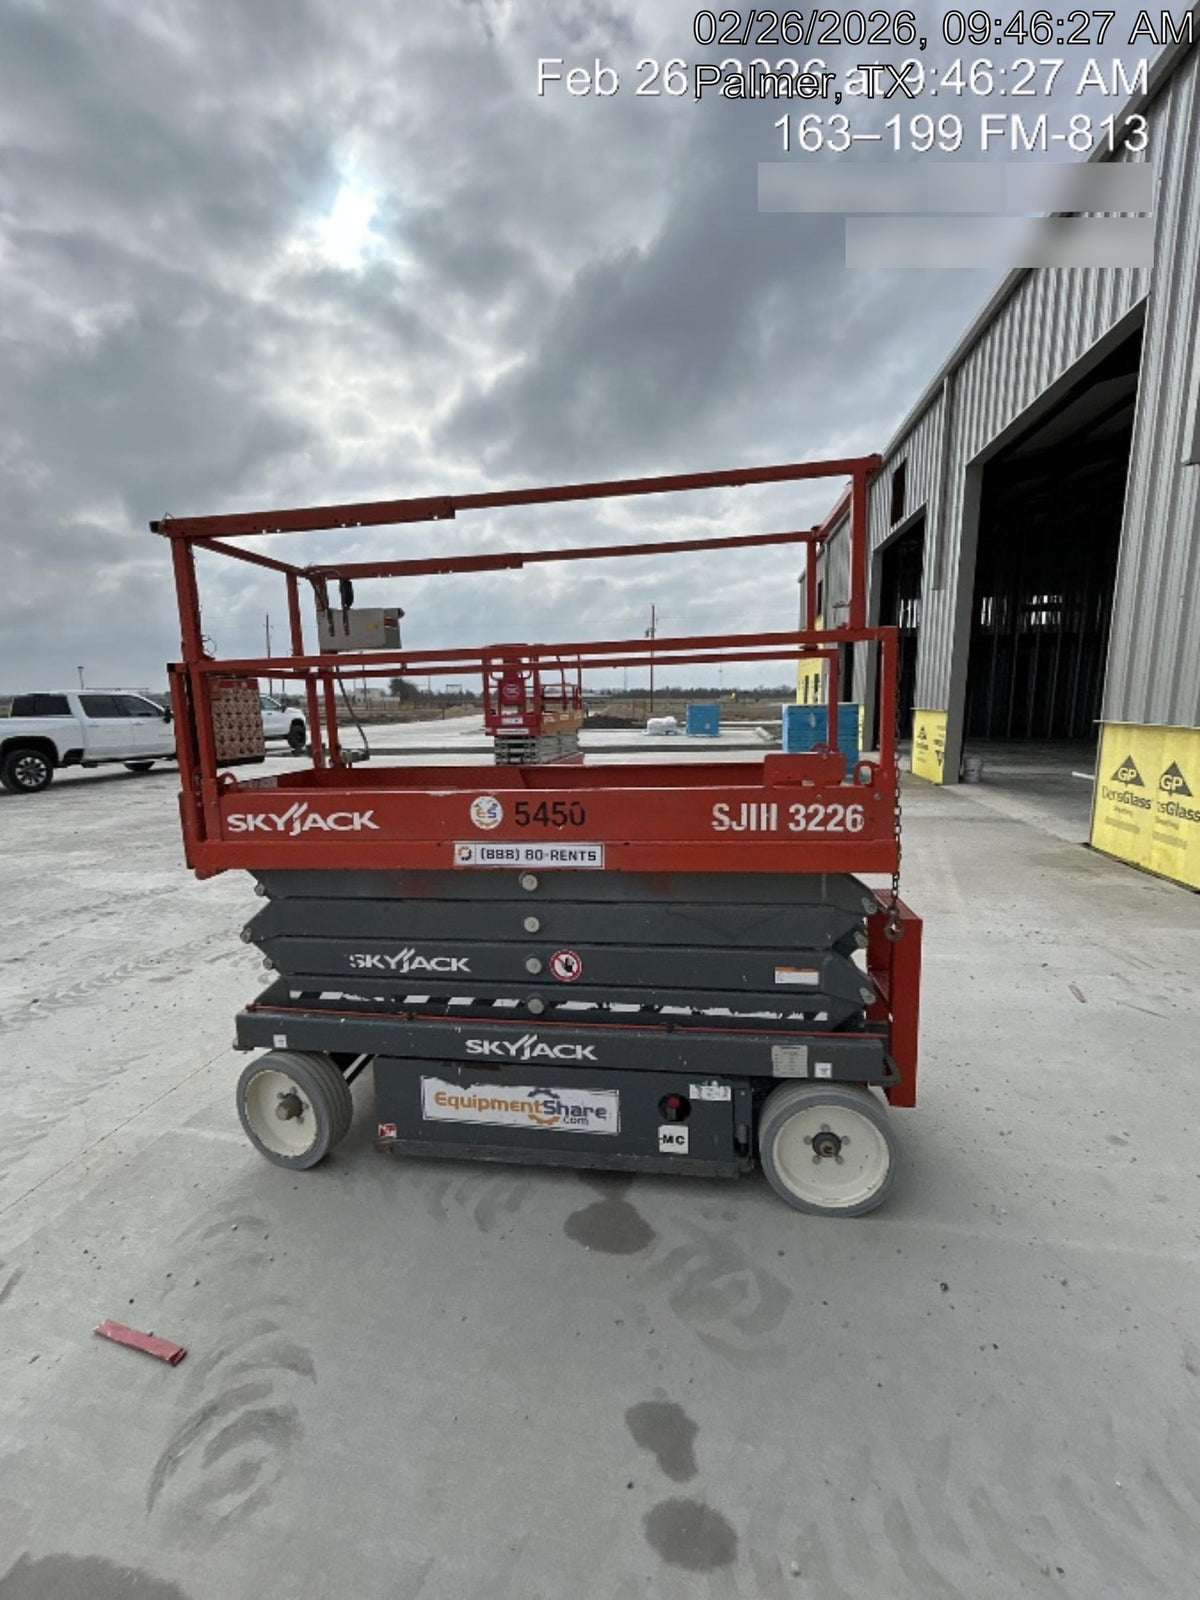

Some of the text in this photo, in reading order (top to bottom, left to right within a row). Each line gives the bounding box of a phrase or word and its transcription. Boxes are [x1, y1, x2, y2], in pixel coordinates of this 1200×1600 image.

[1117, 767, 1137, 782] GP
[1160, 774, 1184, 791] GP
[226, 801, 380, 837] SKYJACK
[514, 801, 586, 828] 5450
[788, 803, 865, 833] 3226
[349, 946, 472, 974] SKYJACK
[465, 1033, 598, 1061] SKYJACK
[434, 1090, 607, 1120] EquipmentShare
